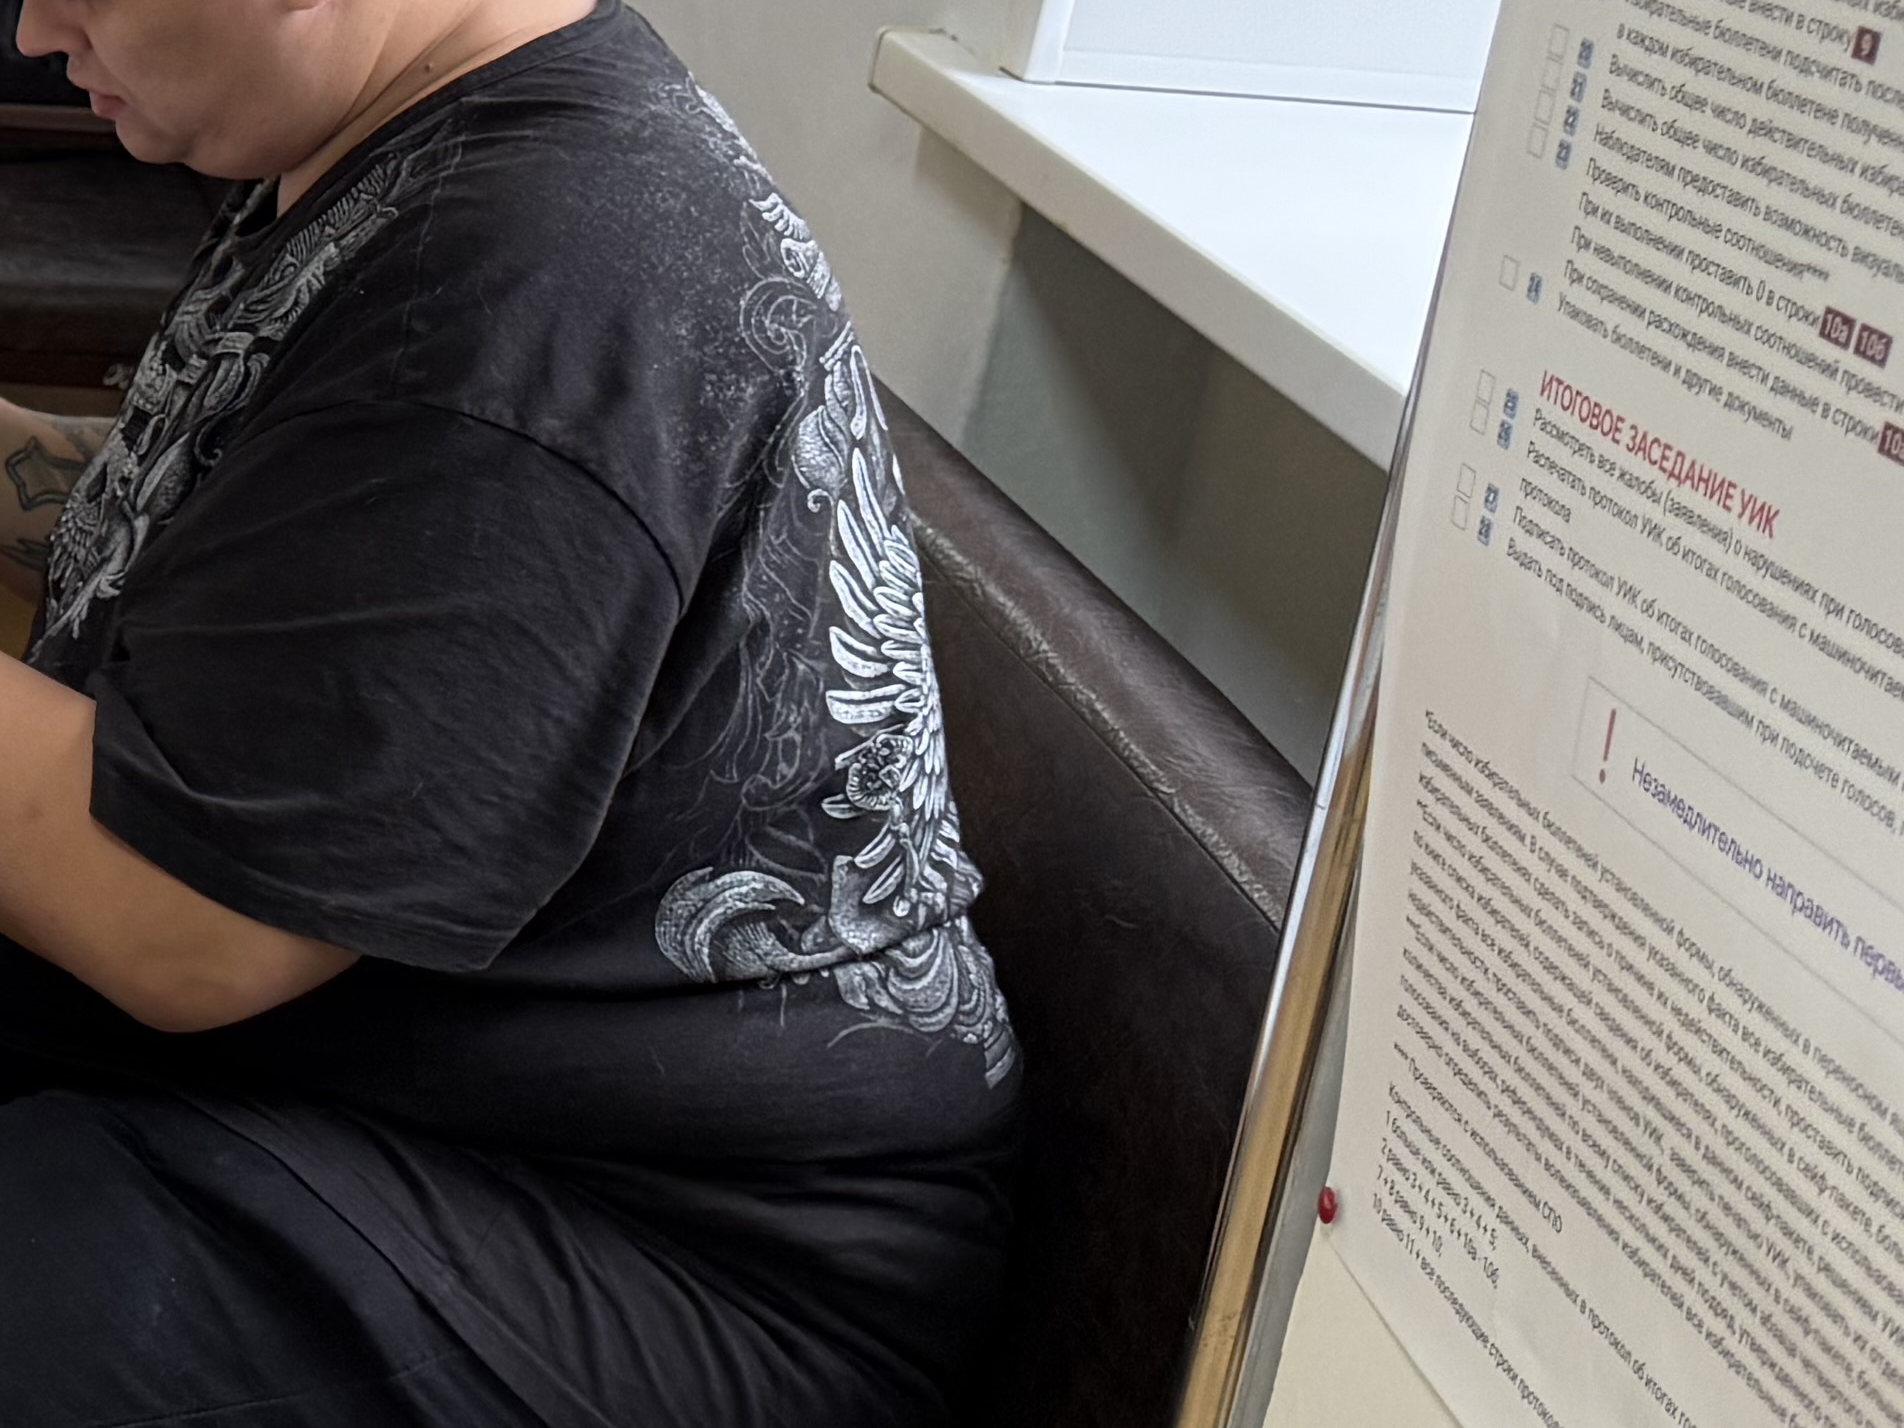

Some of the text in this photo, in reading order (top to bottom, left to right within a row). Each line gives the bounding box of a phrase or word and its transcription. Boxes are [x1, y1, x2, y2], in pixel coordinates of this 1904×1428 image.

[1569, 226, 1592, 258] При
[1753, 319, 1840, 382] соотношений
[1577, 191, 1600, 223] При
[1684, 249, 1755, 301] проставить
[1775, 293, 1820, 334] строки
[1822, 311, 1887, 364] 10а 10б
[1562, 259, 1585, 292] При
[1726, 350, 1769, 387] внести
[1769, 374, 1819, 418] данные
[1831, 407, 1879, 450] строки
[1538, 370, 1778, 539] ИТОГОВОЕ ЗАСЕДАНИЕ УИК
[1616, 462, 1663, 508] жалобы
[1741, 545, 1819, 611] нарушениях
[1817, 593, 1844, 626] при
[1638, 514, 1665, 548] УИК
[1664, 531, 1681, 558] об
[1680, 546, 1718, 583] итогах
[1719, 571, 1798, 635] голосования
[1614, 576, 1640, 609] УИК
[1639, 592, 1656, 620] об
[1655, 608, 1693, 646] итогах
[1693, 634, 1768, 698] голосования
[1644, 640, 1755, 735] присутствовавшим
[1753, 718, 1779, 752] при
[1838, 778, 1899, 838] голосов,
[1629, 763, 1765, 887] Незамедлительно
[1763, 871, 1851, 956] направить
